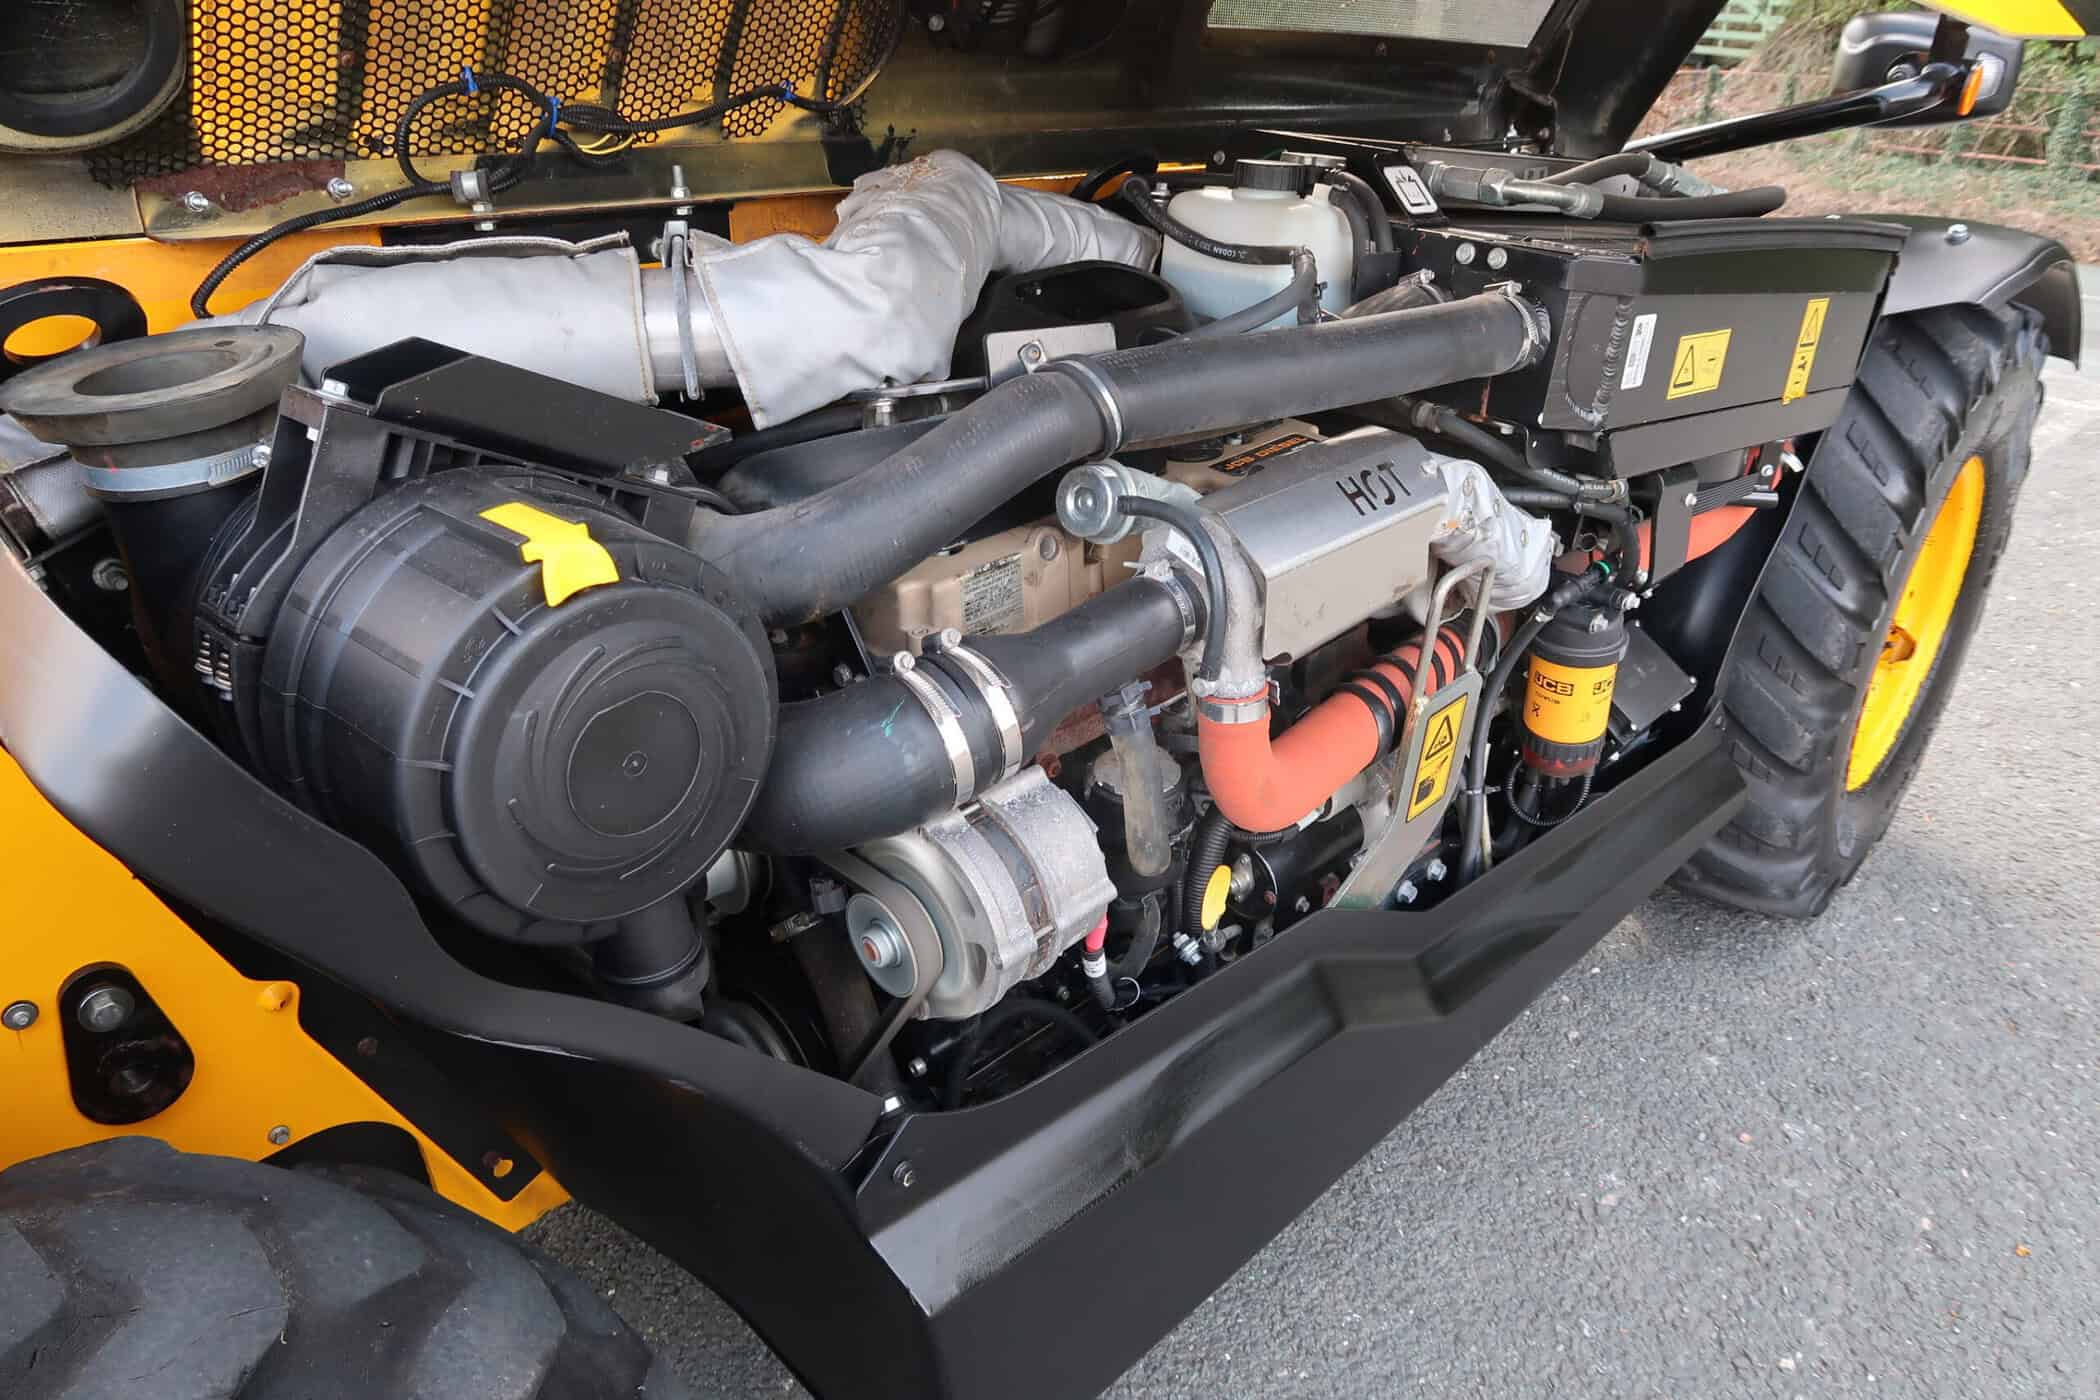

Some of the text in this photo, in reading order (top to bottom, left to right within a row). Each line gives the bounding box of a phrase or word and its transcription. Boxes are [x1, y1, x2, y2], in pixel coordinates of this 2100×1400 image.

[1224, 455, 1256, 471] JCB
[1335, 460, 1412, 517] HOT
[1535, 671, 1574, 697] JCB
